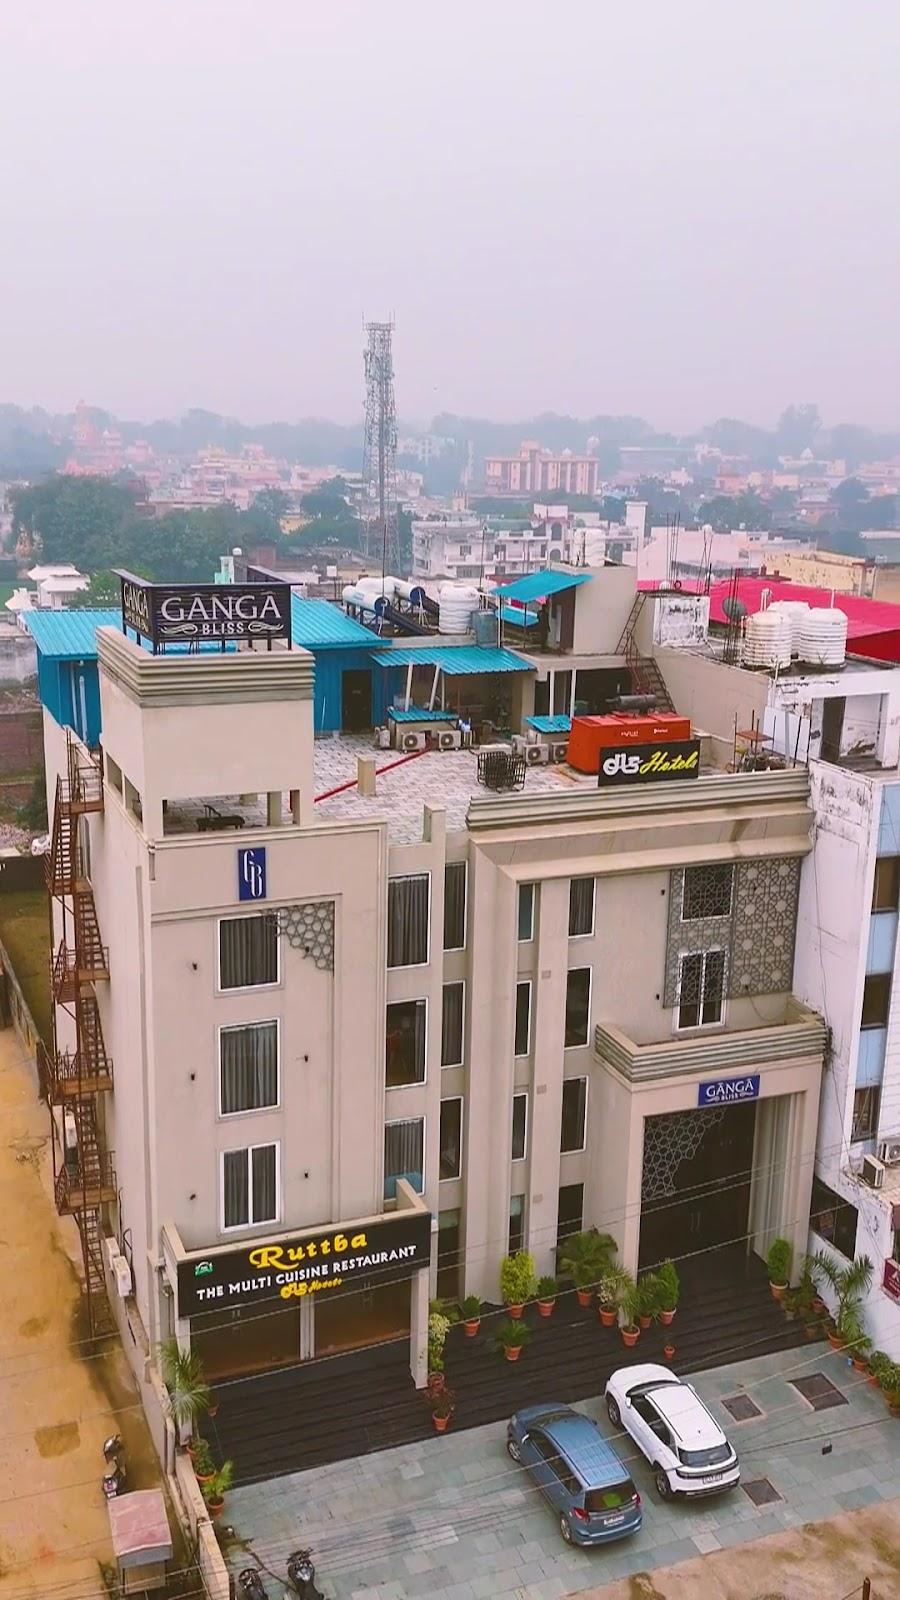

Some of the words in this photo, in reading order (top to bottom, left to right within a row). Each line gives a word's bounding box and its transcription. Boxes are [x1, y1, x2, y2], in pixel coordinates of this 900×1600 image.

[202, 622, 245, 636] BLISS
[249, 1233, 368, 1270] Ruttba
[196, 1285, 225, 1301] THE
[228, 1276, 271, 1295] MULTI
[275, 1265, 329, 1285] CUISINE
[332, 1245, 417, 1273] RESTAURANT
